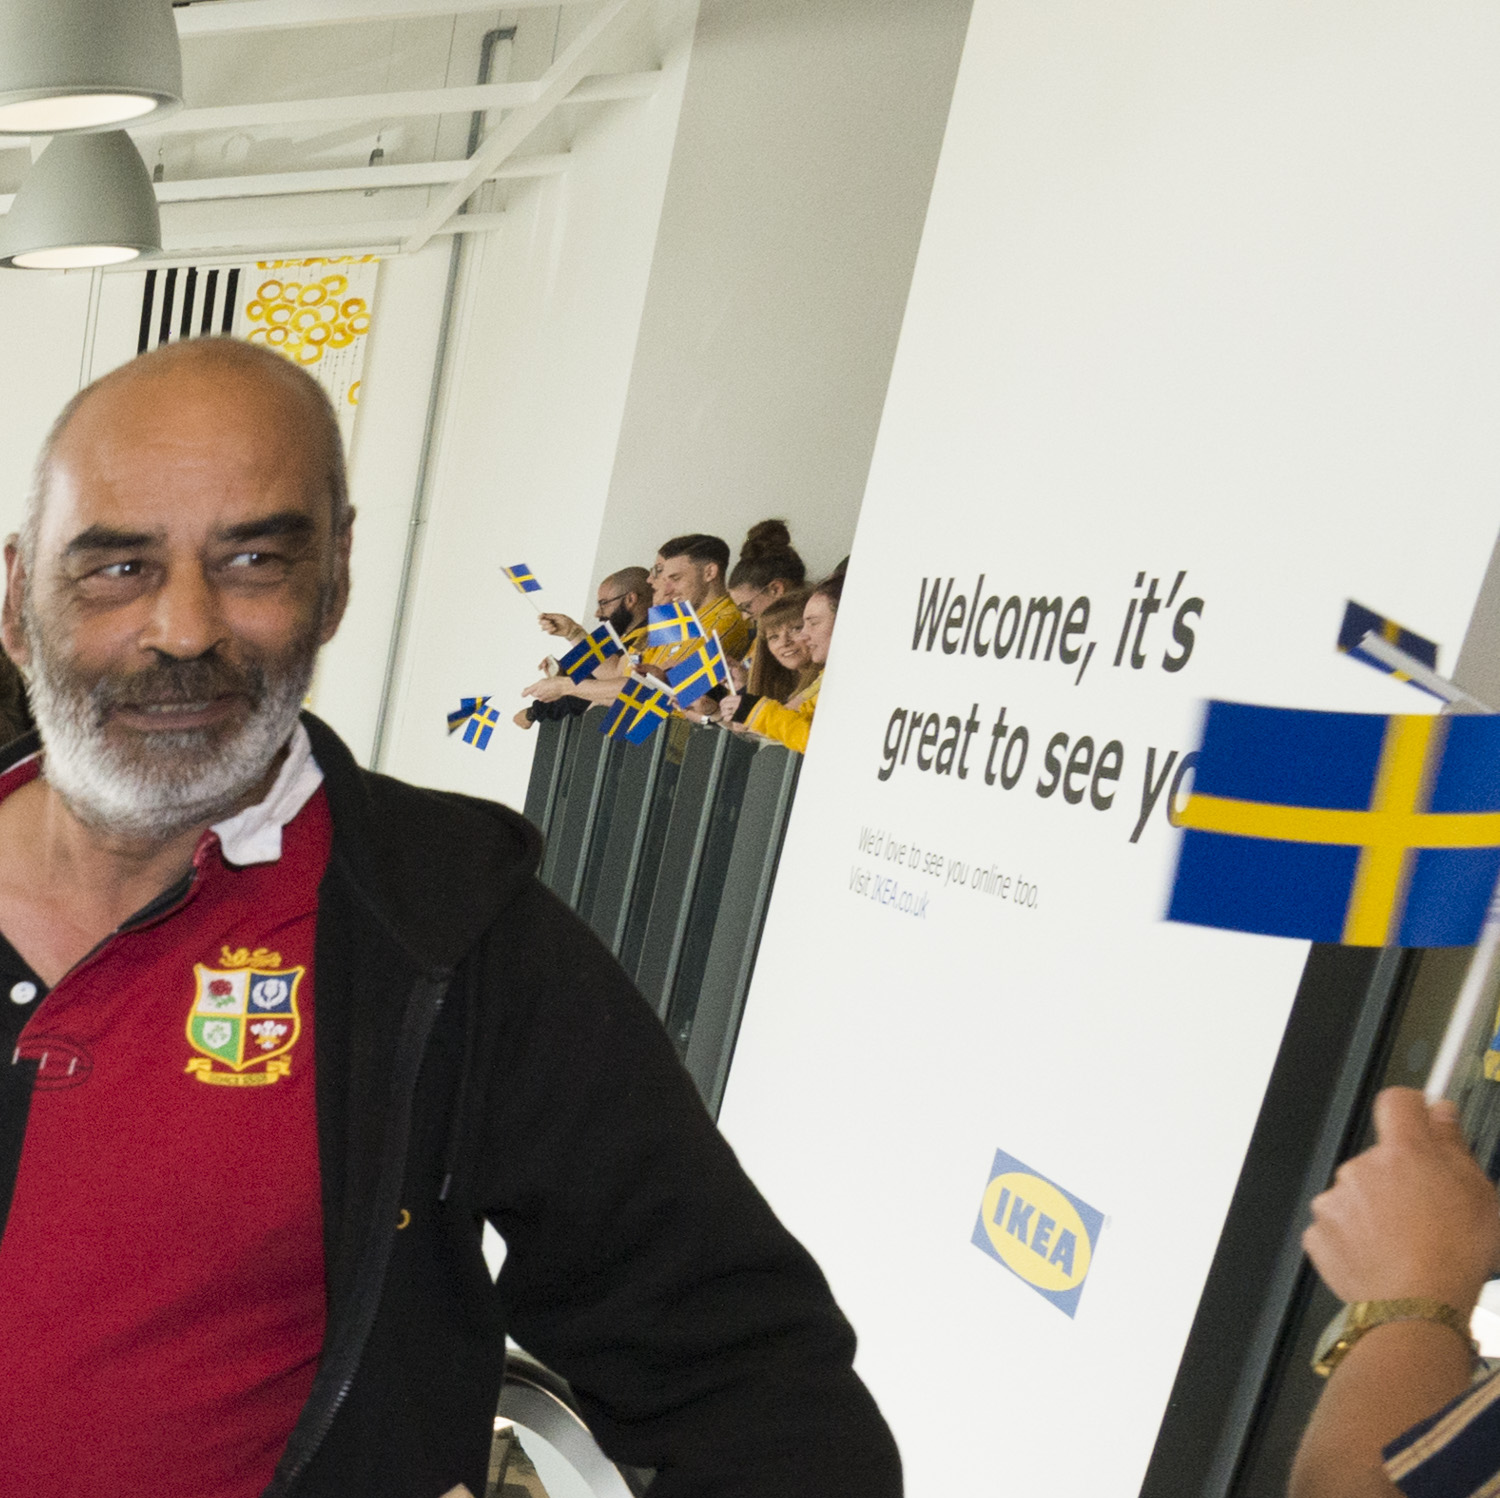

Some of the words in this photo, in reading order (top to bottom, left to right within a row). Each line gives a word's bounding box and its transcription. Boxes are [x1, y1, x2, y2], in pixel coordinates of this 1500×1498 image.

[911, 573, 1098, 686] Welcome,
[877, 703, 981, 782] great
[984, 706, 1030, 791] to
[1035, 731, 1125, 812] see
[849, 865, 872, 897] Visit
[870, 873, 931, 920] IKEA.co.uk
[884, 832, 907, 866] love
[908, 842, 921, 870] to
[922, 851, 944, 878] see
[944, 858, 970, 888] you
[971, 863, 1013, 900] online
[1013, 874, 1039, 910] too.
[992, 1186, 1077, 1278] IKEA
